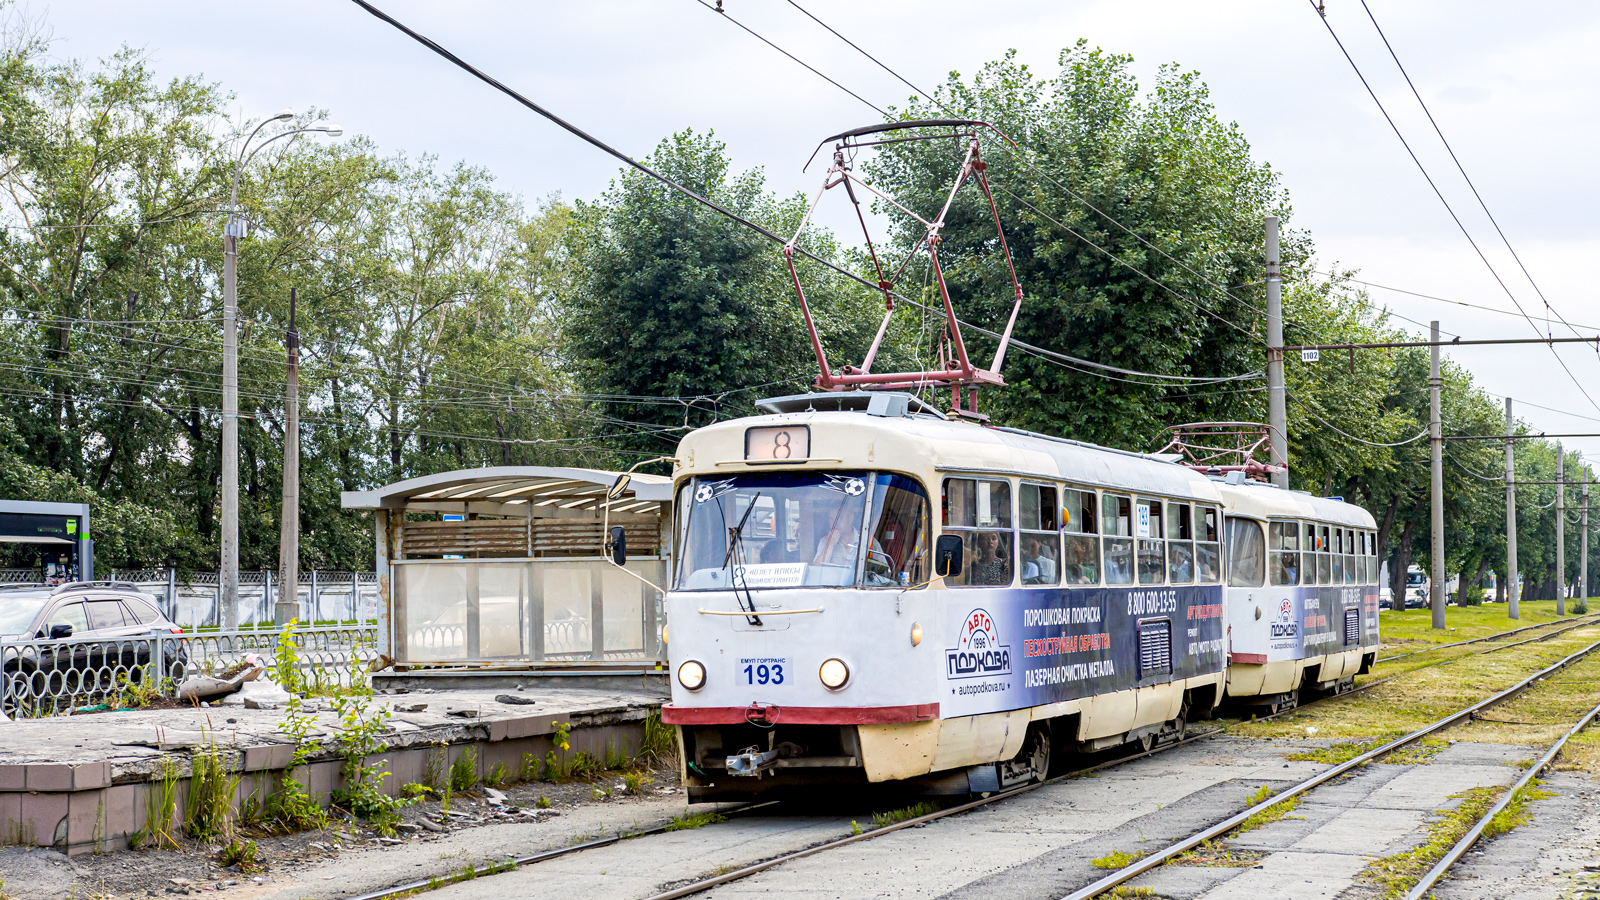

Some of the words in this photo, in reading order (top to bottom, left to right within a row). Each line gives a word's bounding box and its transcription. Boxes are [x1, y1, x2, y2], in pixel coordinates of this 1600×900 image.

[1303, 351, 1318, 360] 1102
[773, 431, 792, 459] 8
[1127, 592, 1133, 615] 8
[1133, 591, 1145, 615] 800
[1146, 590, 1176, 614] 600-13-55
[1280, 601, 1292, 614] АВТО
[968, 613, 991, 635] АВТО
[1024, 607, 1071, 627] ПОРОШКОВАЯ
[1071, 606, 1101, 624] ПОКРАСКА
[973, 637, 986, 649] 1996
[1024, 631, 1078, 658] ПЕСКОСТРУЙНАЯ
[1078, 632, 1111, 652] ОБРАБОТКА
[948, 650, 1010, 675] ПОДКОВА
[743, 664, 784, 685] 193
[1025, 666, 1060, 688] ЛАЗЕРНАЯ
[1060, 662, 1088, 683] ОЧИСТКА
[1088, 659, 1115, 679] МЕТАЛЛА
[958, 681, 1006, 697] autopodkova.ru
